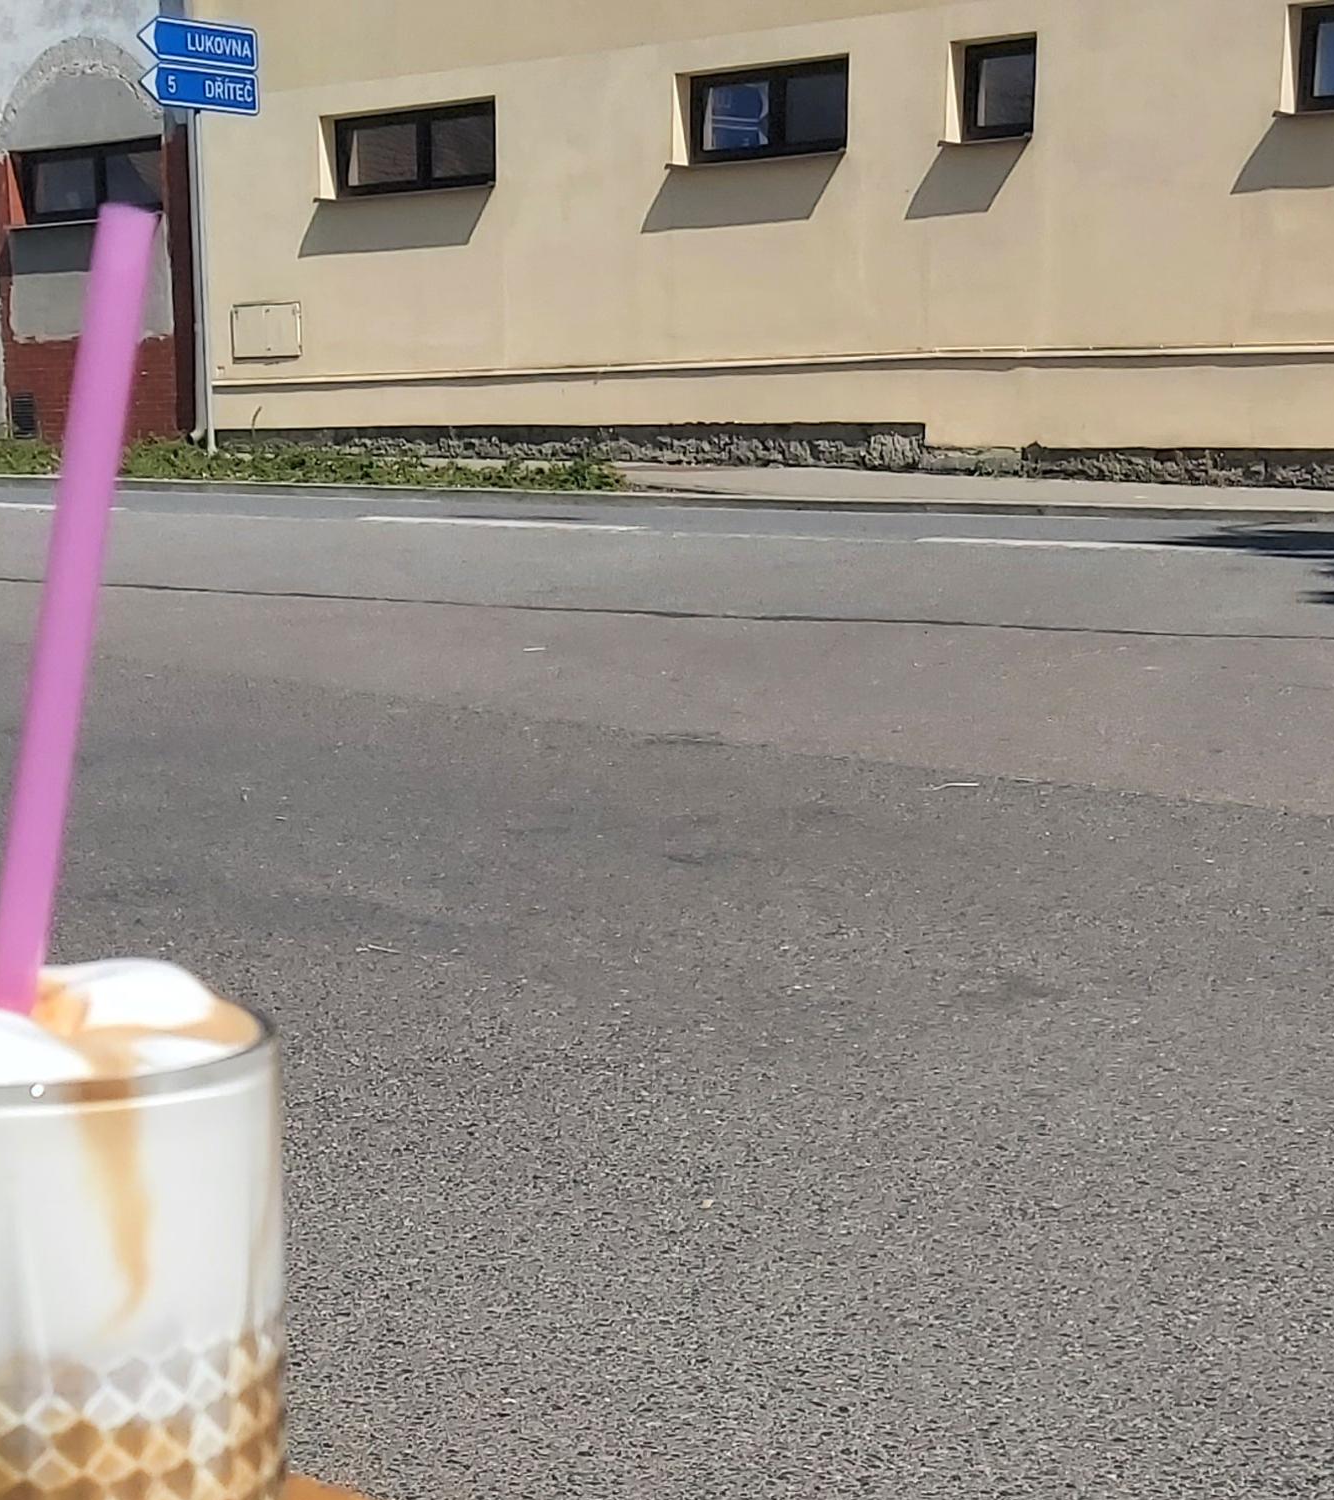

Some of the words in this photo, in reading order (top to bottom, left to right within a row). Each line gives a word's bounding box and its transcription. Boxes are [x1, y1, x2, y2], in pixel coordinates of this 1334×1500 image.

[186, 32, 252, 58] LUKOVNA
[167, 75, 177, 93] 5
[204, 76, 253, 102] DŘÍTEČ
